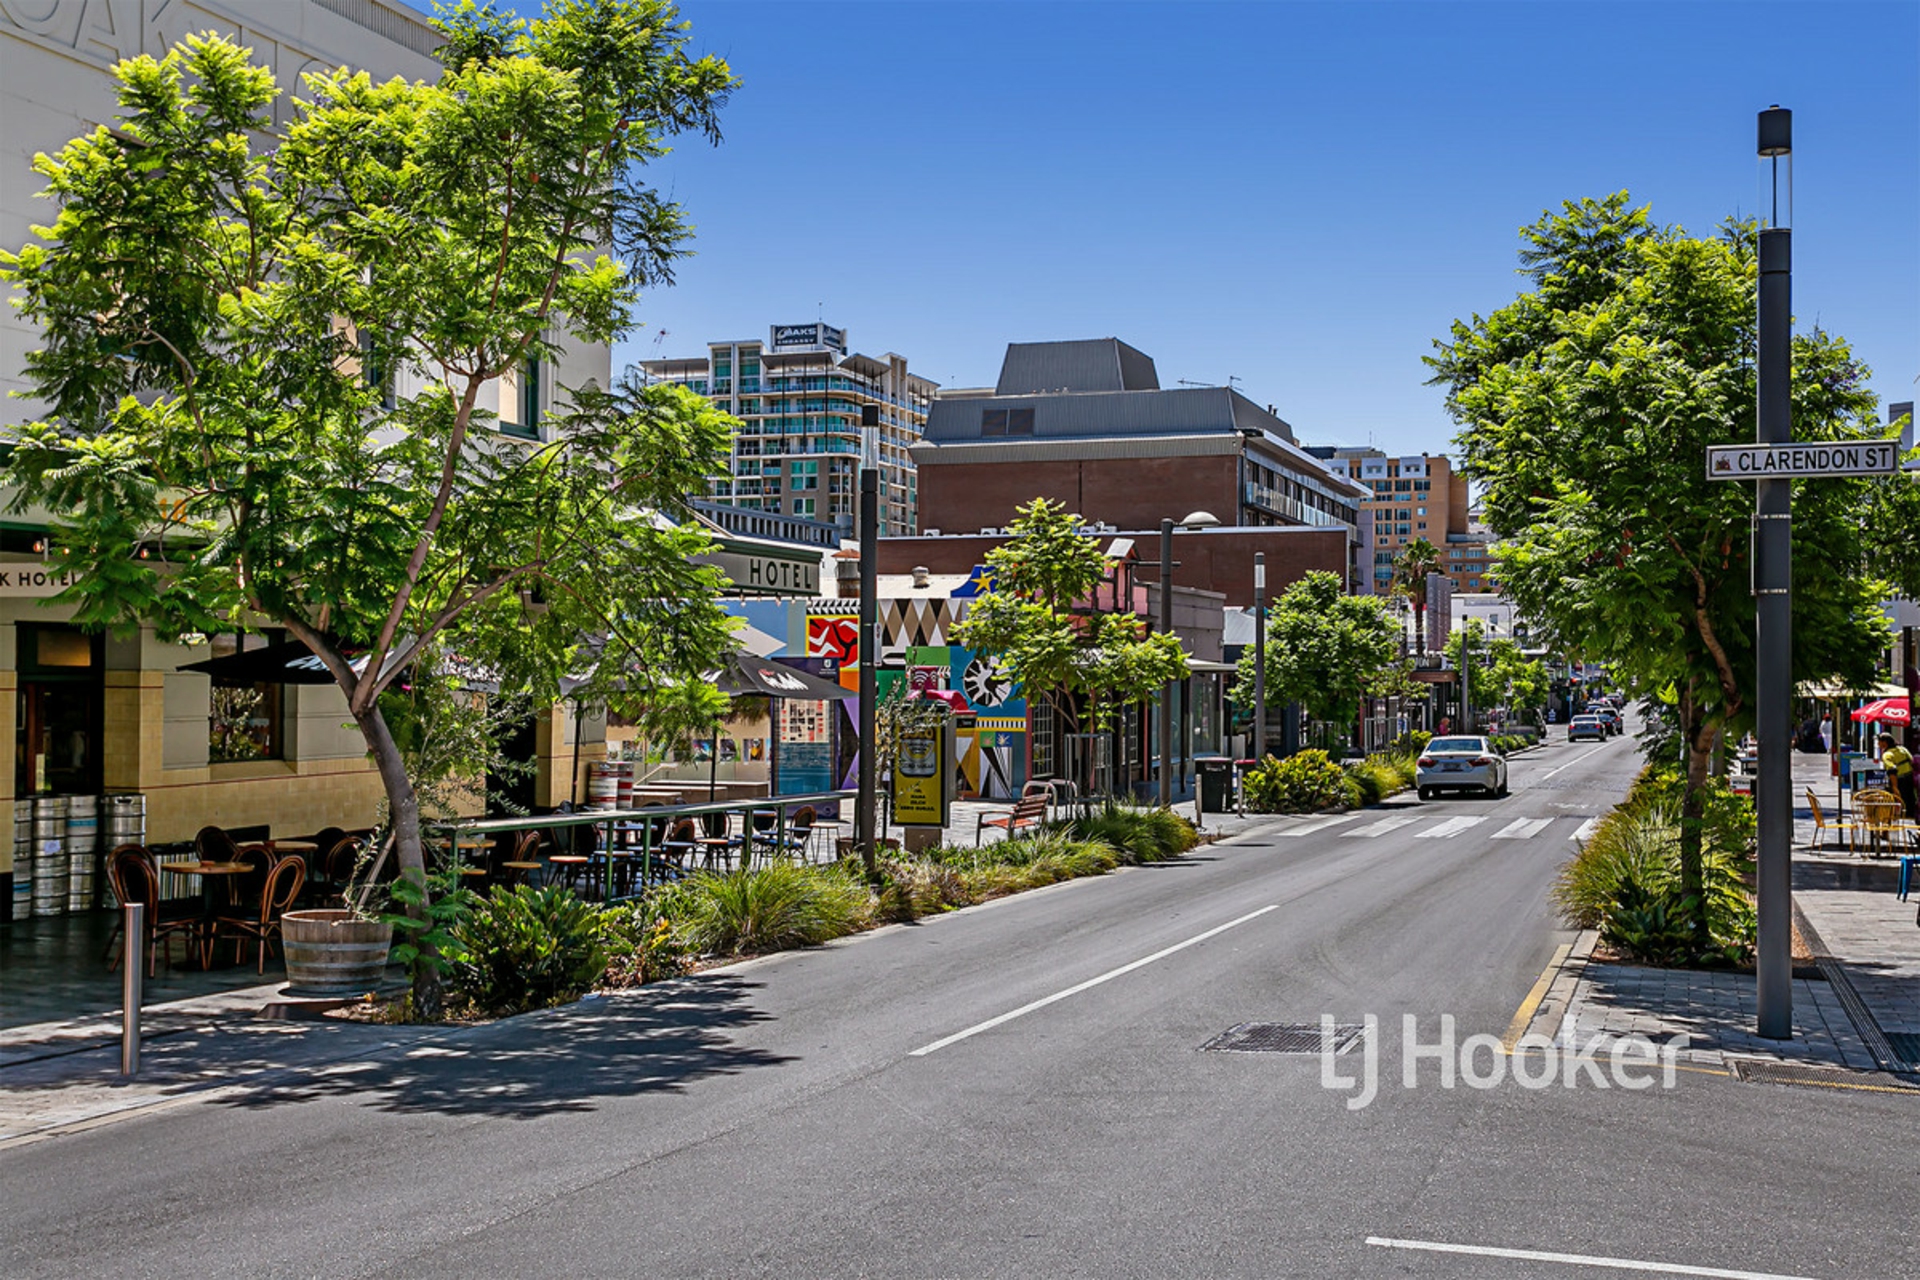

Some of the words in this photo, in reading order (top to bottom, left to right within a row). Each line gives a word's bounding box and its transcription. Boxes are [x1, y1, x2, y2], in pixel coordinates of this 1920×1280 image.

[1738, 449, 1859, 471] CLARENDON
[1865, 447, 1890, 468] ST
[750, 559, 811, 589] HOTEL
